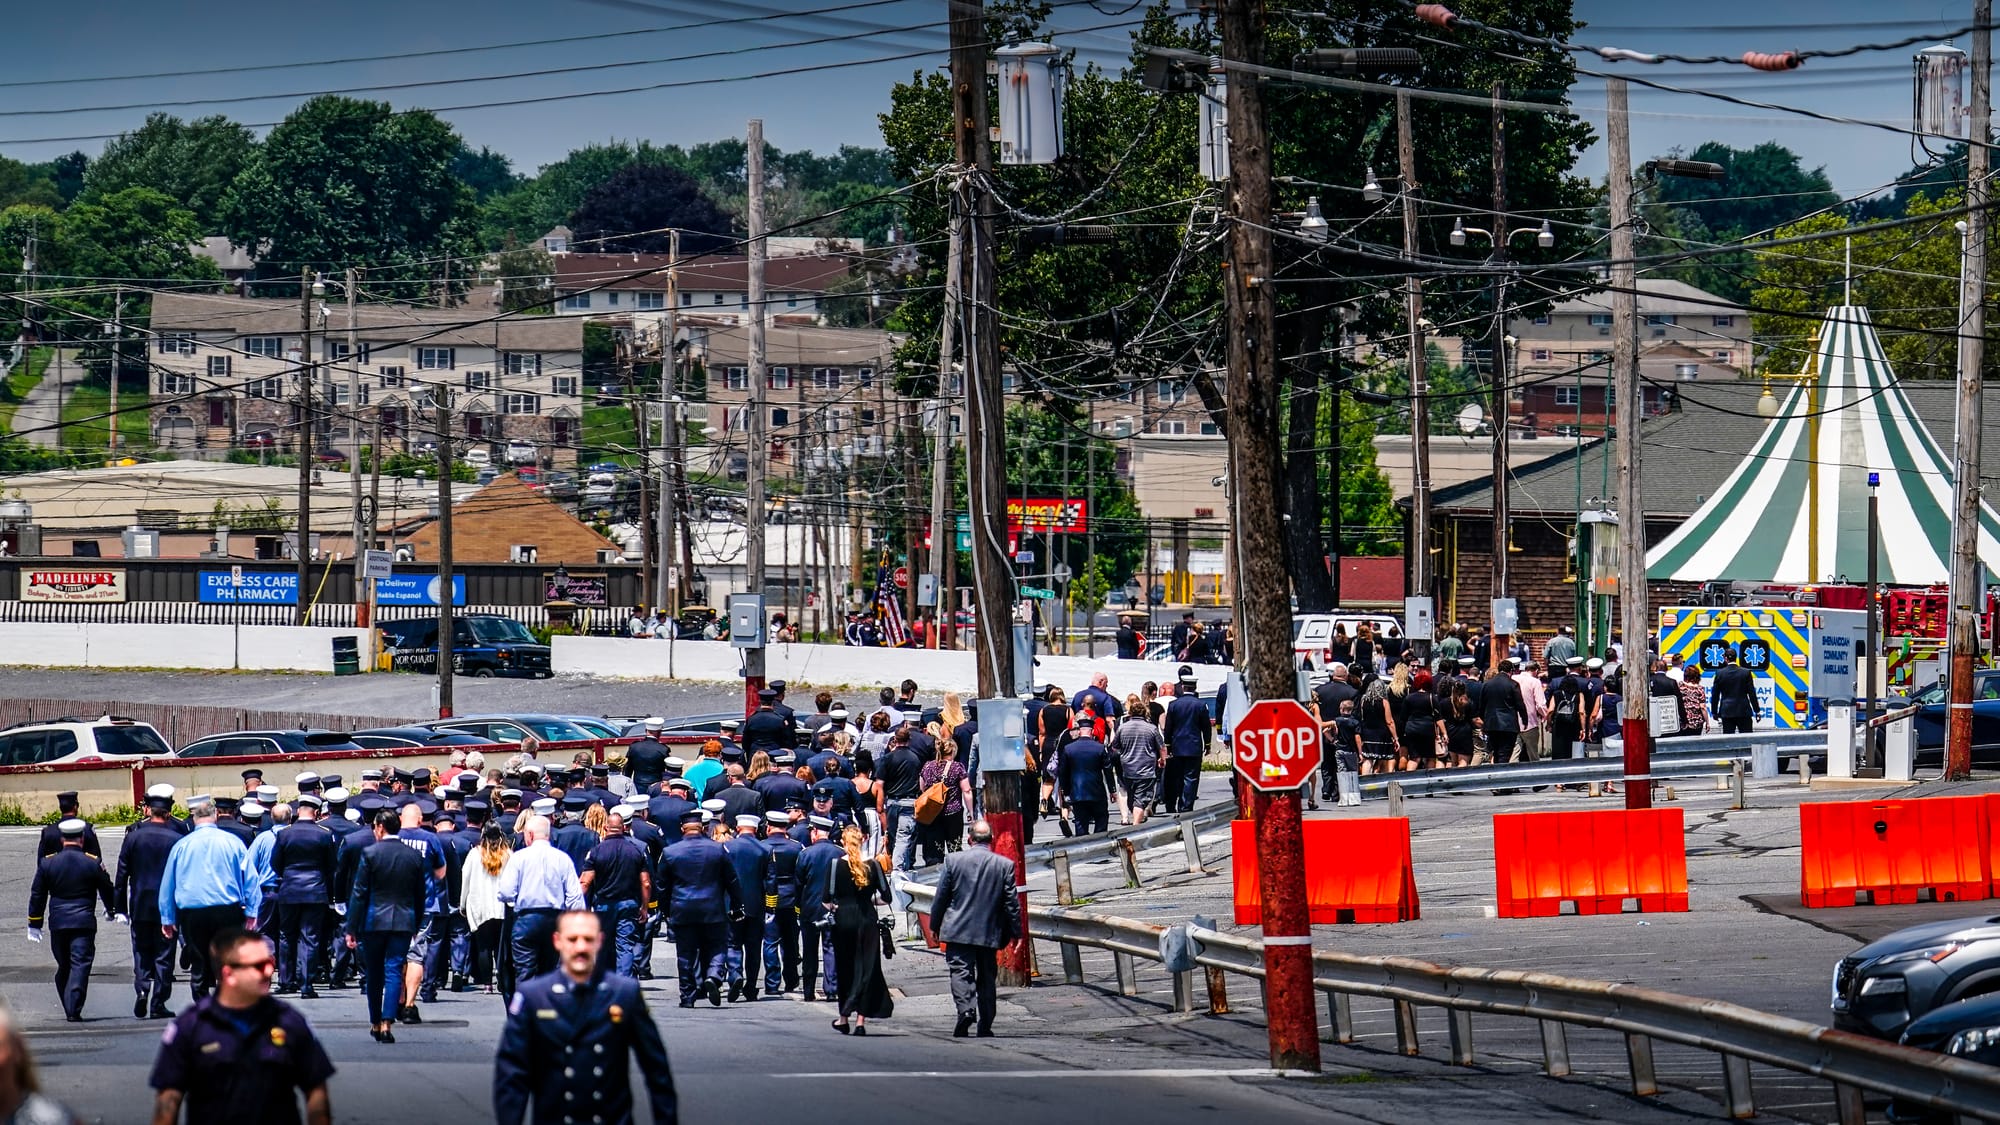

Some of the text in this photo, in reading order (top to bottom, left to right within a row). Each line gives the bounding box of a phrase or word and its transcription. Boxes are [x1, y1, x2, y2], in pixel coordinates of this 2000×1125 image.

[36, 573, 110, 584] MADELINE'S
[208, 575, 297, 587] EXPESS CARE
[895, 573, 907, 582] STO
[385, 580, 416, 588] Delivery
[99, 590, 118, 599] More
[216, 588, 288, 600] PHARMACY
[409, 654, 435, 665] GUARD
[1823, 650, 1848, 661] COMMUNITY
[1823, 664, 1849, 675] AMBULANCE
[1239, 727, 1315, 762] STOP
